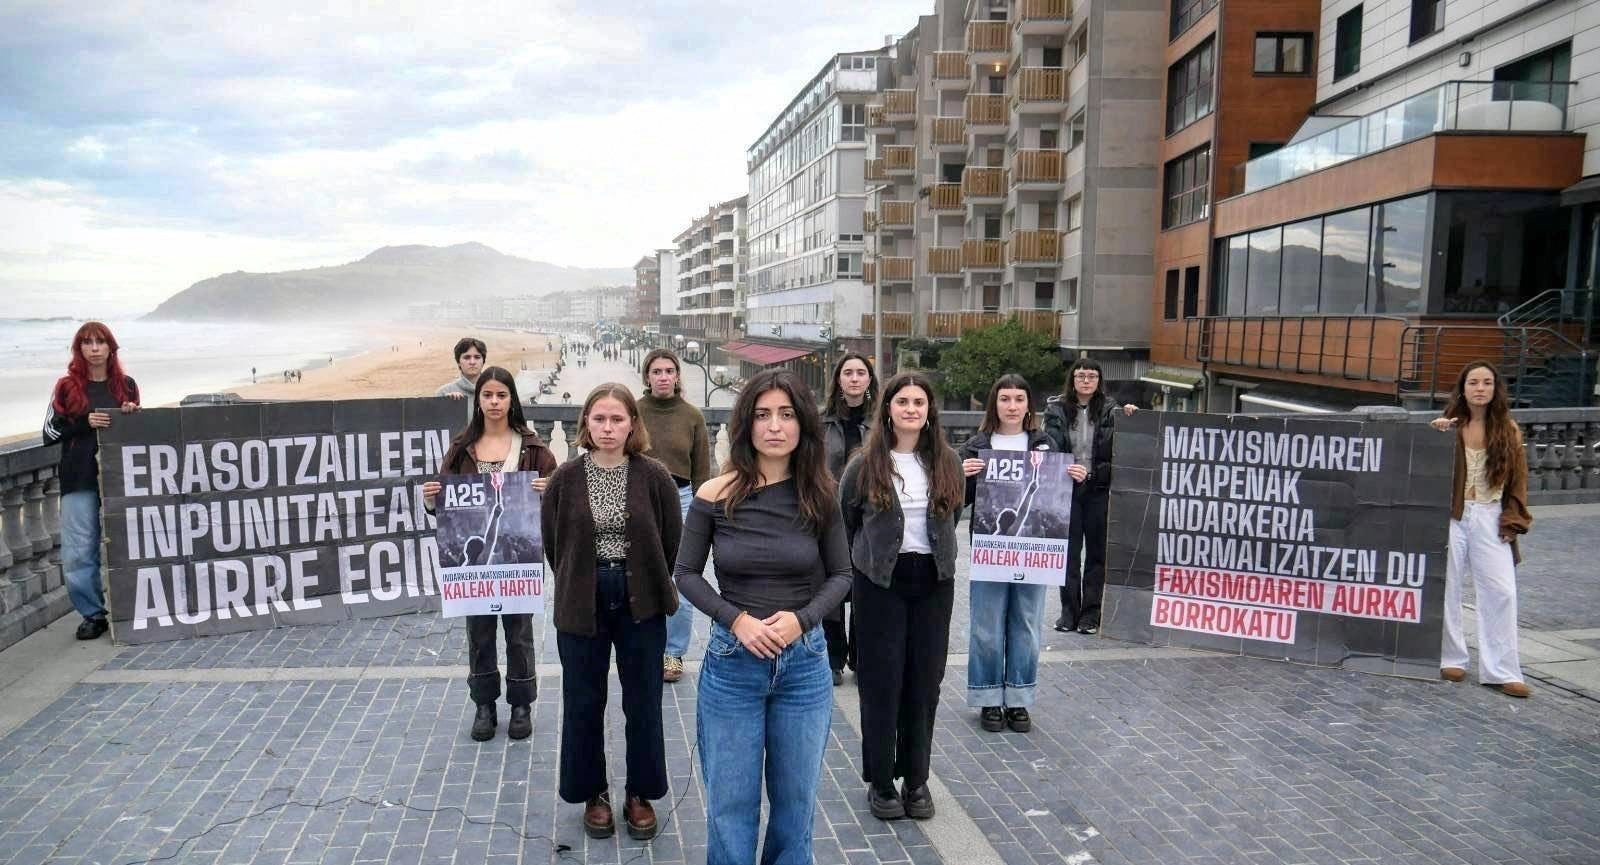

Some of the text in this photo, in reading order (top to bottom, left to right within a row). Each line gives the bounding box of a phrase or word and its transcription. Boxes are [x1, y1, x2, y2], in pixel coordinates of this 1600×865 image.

[121, 429, 450, 497] ERASOTZAILEEN
[986, 459, 1024, 480] A25
[1163, 426, 1383, 473] MATXISMOAREN
[445, 483, 485, 506] A25
[1160, 462, 1302, 504] UKAPENAK
[1159, 498, 1315, 542] INDARKERIA
[973, 549, 1065, 570] KALEAK HARTU
[1157, 532, 1427, 587] NORMALIZATZEN DU
[133, 550, 323, 630] AURRE
[443, 579, 541, 600] KALEAK HARTU
[1158, 566, 1418, 620] FAXISMOAREN AURKA
[1155, 599, 1293, 641] BORROKATU
